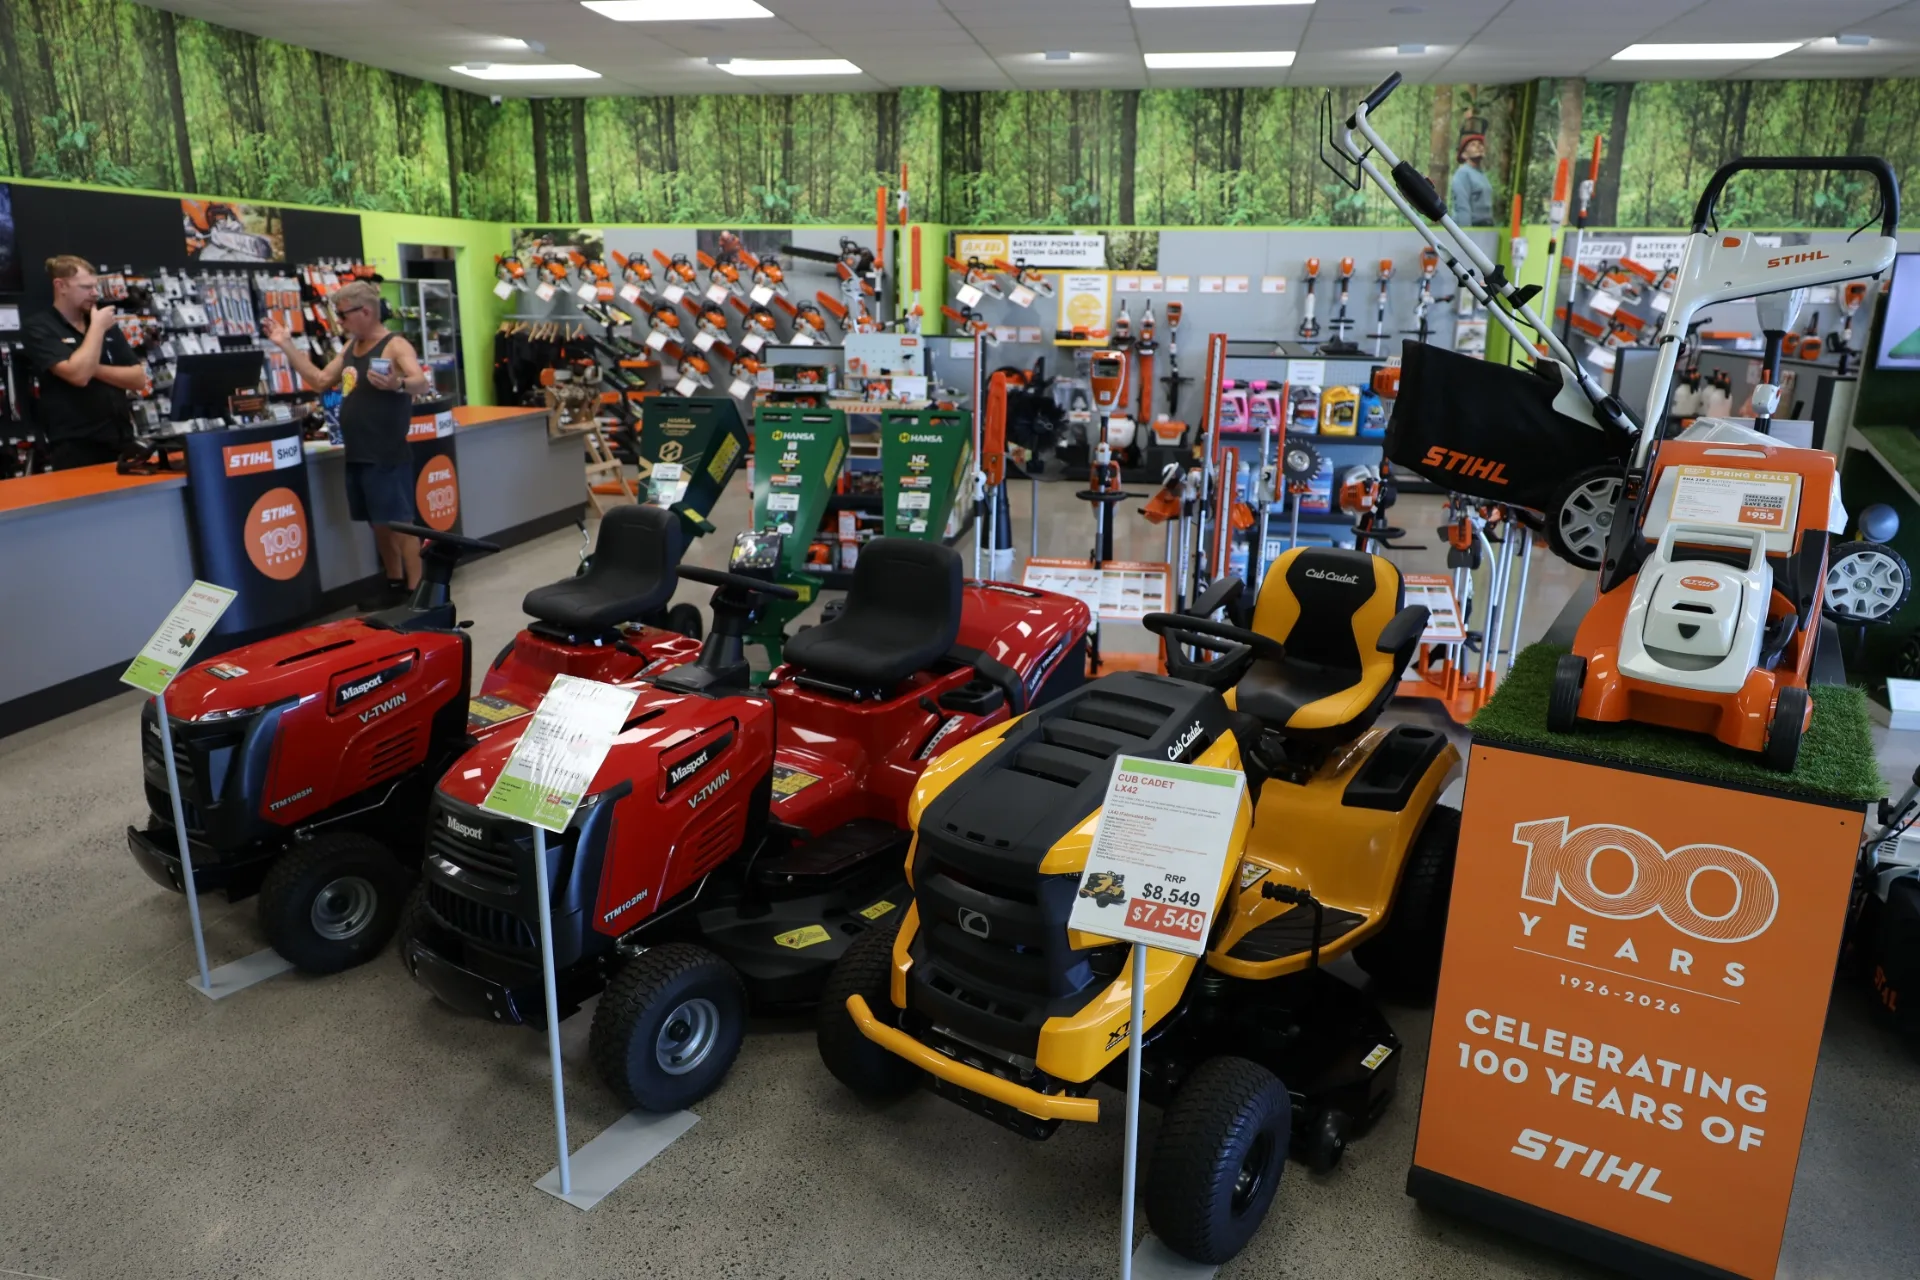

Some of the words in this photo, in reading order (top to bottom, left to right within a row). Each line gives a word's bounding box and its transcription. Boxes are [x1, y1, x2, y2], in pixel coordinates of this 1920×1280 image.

[1012, 239, 1049, 248] BATTERY
[1050, 240, 1081, 248] POWER
[1082, 240, 1100, 248] FOR
[1012, 248, 1046, 256] MEDIUM
[1635, 251, 1680, 259] GARDENS
[1767, 250, 1830, 269] STIHL
[407, 422, 435, 435] STIHL
[783, 431, 815, 441] HANSA
[910, 434, 943, 443] HANSA
[229, 450, 272, 468] STIHL
[276, 445, 298, 460] SHOP
[783, 452, 798, 461] NZ
[911, 454, 927, 464] NZ
[1421, 445, 1509, 485] STIHL
[428, 468, 451, 484] STIHL
[1709, 470, 1750, 479] SPRING
[1754, 473, 1790, 482] DEALS
[426, 485, 454, 511] 100
[261, 503, 297, 523] STIHL
[1746, 511, 1775, 520] $955
[260, 523, 302, 557] 100
[266, 549, 302, 567] YEARS
[1305, 568, 1325, 579] Cub
[1325, 571, 1359, 585] Cadet
[341, 674, 383, 701] Masport
[358, 692, 407, 723] V-TWIN
[1167, 739, 1184, 761] Cub
[1181, 720, 1204, 748] Cadet
[670, 751, 708, 784] Masport
[687, 770, 731, 809] V-TWIN
[1114, 783, 1139, 795] LX42
[1117, 773, 1139, 784] CUB
[1140, 776, 1175, 790] CADET
[447, 815, 483, 840] Masport
[1164, 873, 1187, 884] RRP
[1512, 815, 1779, 944] 100
[603, 888, 648, 923] TTM102RH
[1142, 882, 1201, 908] $8,549
[1132, 903, 1204, 933] $7,549
[1519, 912, 1746, 987] YEARS
[1559, 973, 1681, 1015] 1926-2026
[1465, 1008, 1768, 1113] CELEBRATING
[1458, 1041, 1530, 1085] 100
[1544, 1066, 1683, 1132] YEARS
[1700, 1115, 1766, 1153] OF
[1510, 1127, 1673, 1204] STIHL
